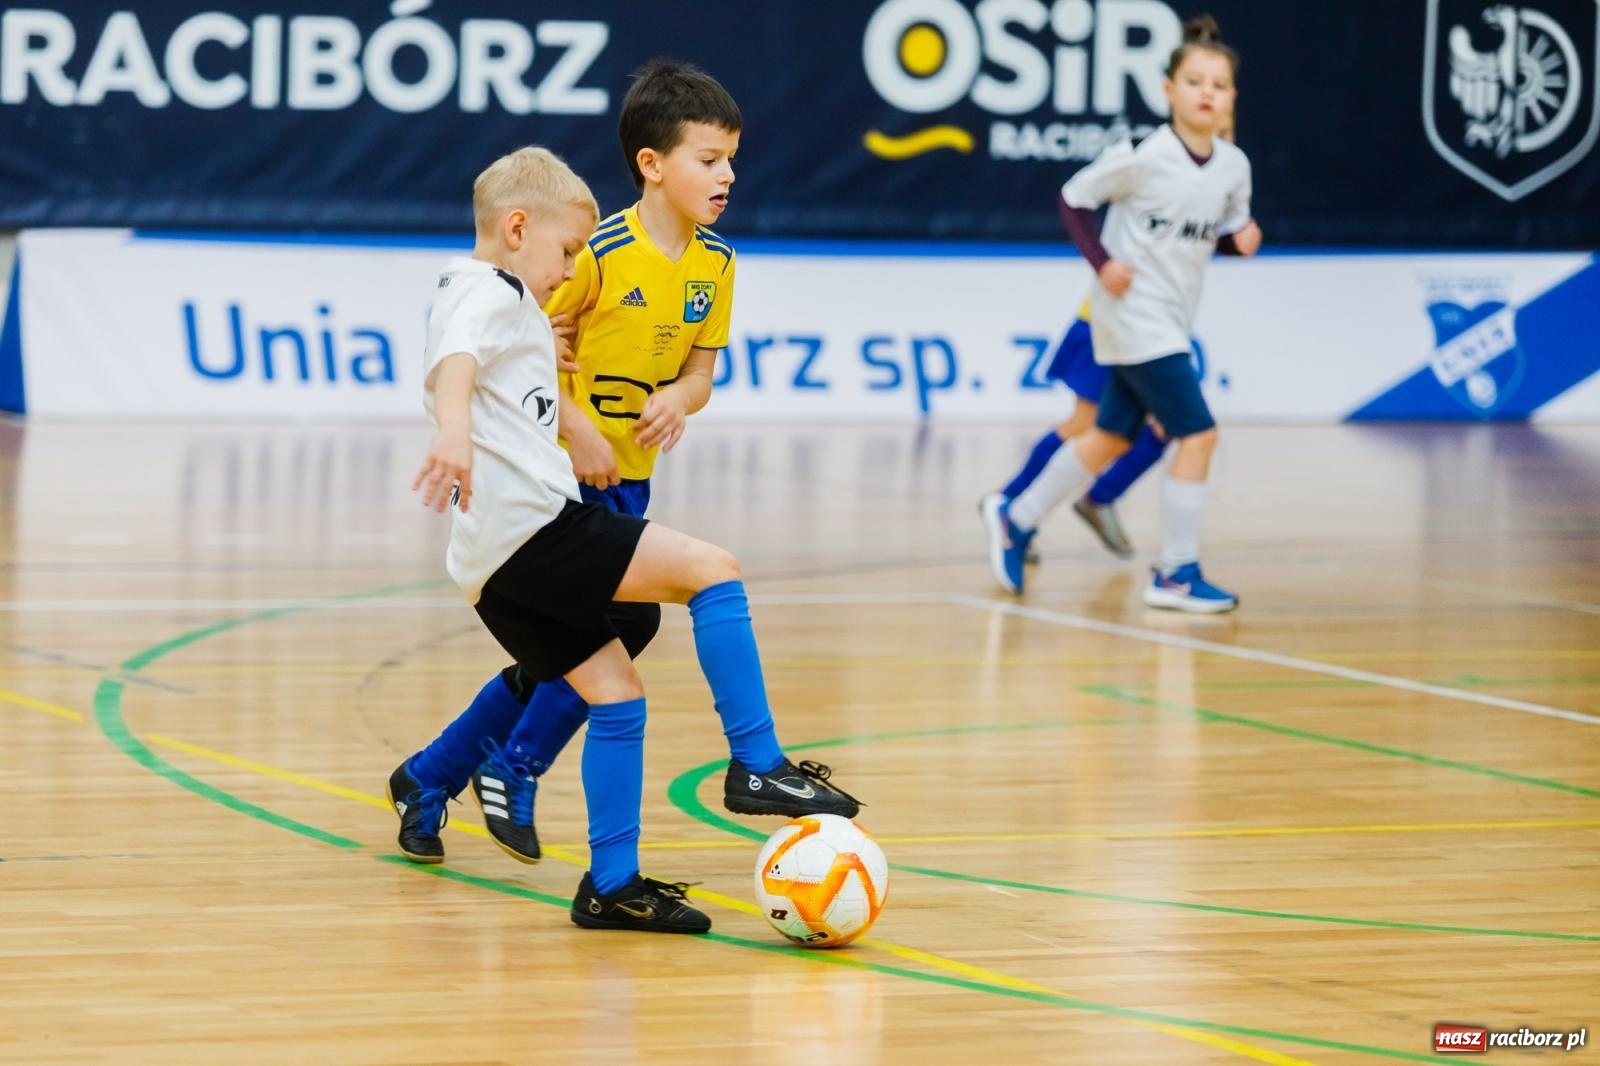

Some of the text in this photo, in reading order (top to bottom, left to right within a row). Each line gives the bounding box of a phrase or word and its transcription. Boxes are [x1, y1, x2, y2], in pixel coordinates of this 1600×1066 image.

[0, 0, 610, 115] RACIBÓRZ
[180, 301, 396, 384] Unia
[860, 334, 984, 413] sp.
[620, 299, 647, 307] adidas
